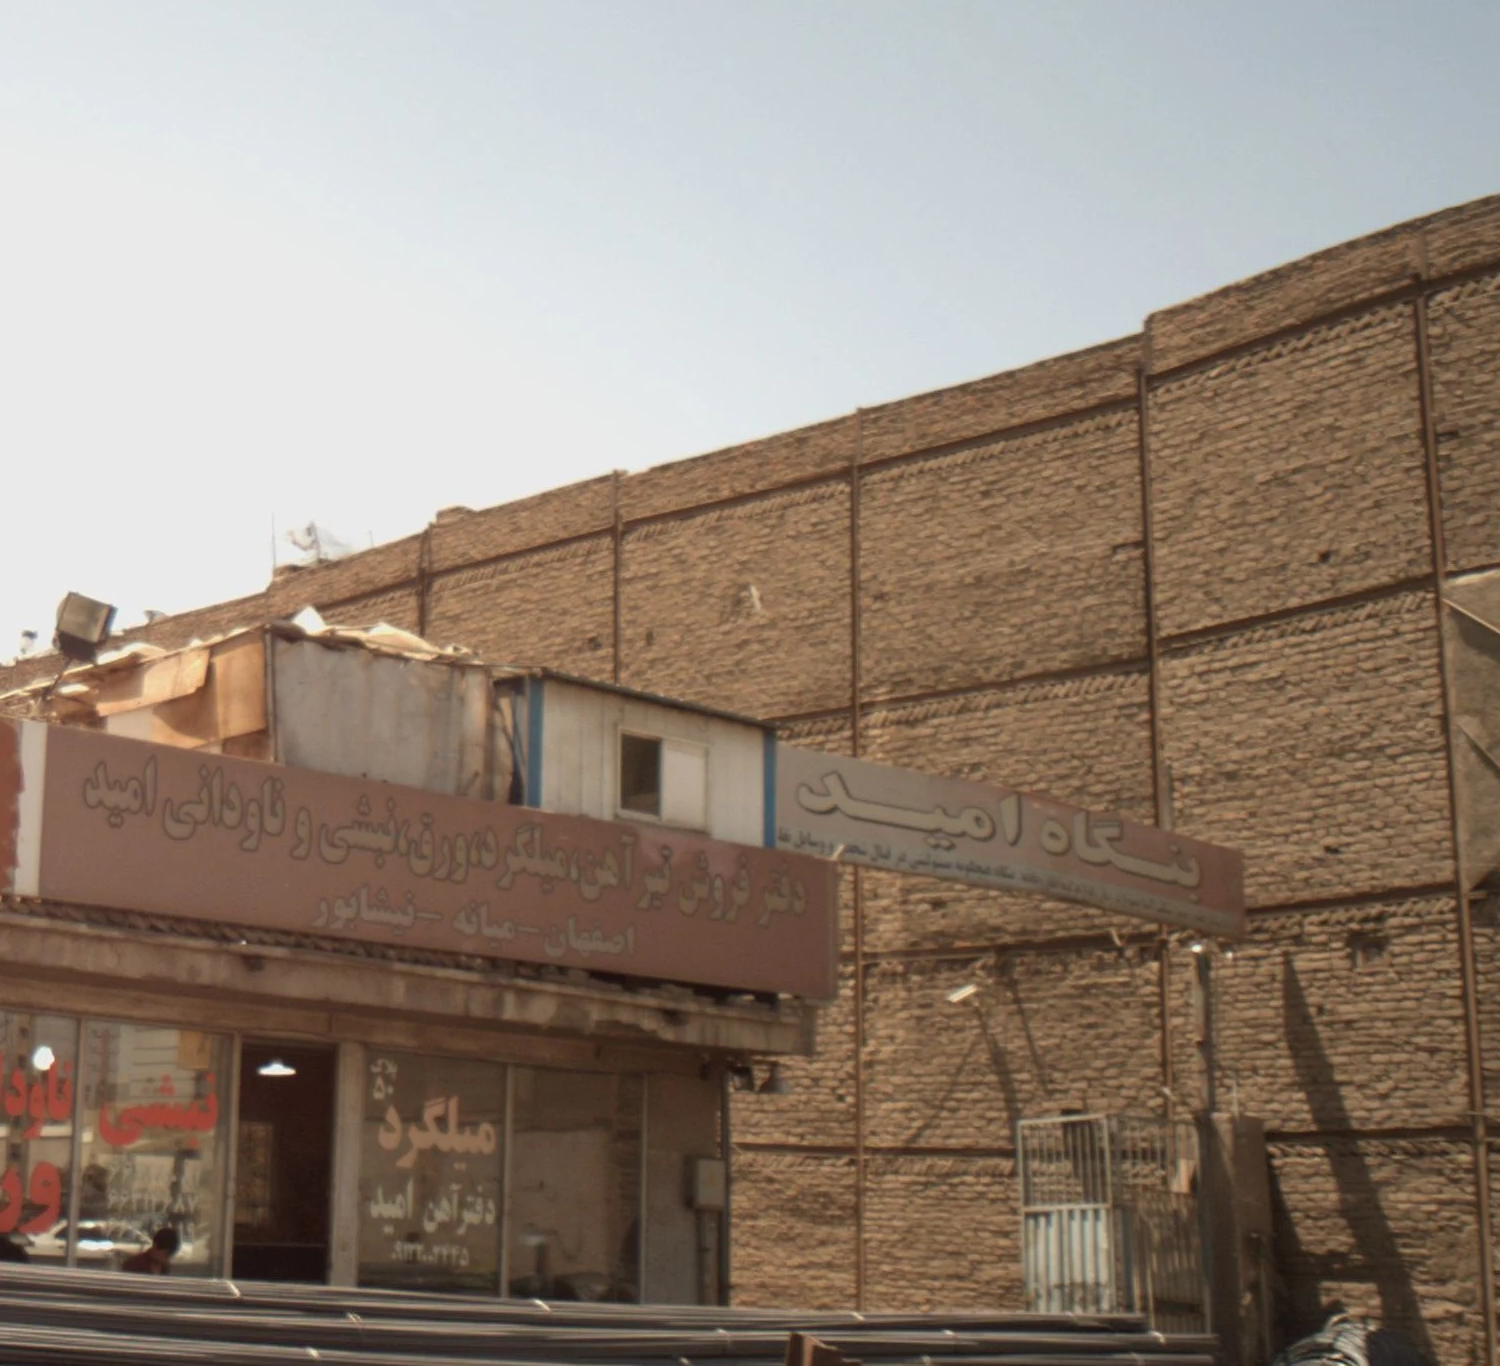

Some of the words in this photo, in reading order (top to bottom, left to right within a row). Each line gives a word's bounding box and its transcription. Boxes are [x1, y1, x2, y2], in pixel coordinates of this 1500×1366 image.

[84, 754, 159, 830] امید
[163, 764, 286, 852] ناودانی
[797, 770, 1025, 851] امید
[291, 805, 313, 860] و
[1039, 809, 1202, 904] بنگاه
[310, 883, 416, 934] نیشابور
[679, 851, 752, 923] فروش
[758, 863, 807, 930] دفتر
[452, 902, 517, 949] میانه
[543, 914, 635, 958] اصفهان
[98, 1072, 218, 1148] نبشی
[377, 1094, 496, 1169] میلگرد
[369, 1175, 415, 1235] امید
[422, 1182, 463, 1234] آهن
[456, 1184, 496, 1237] دفتر
